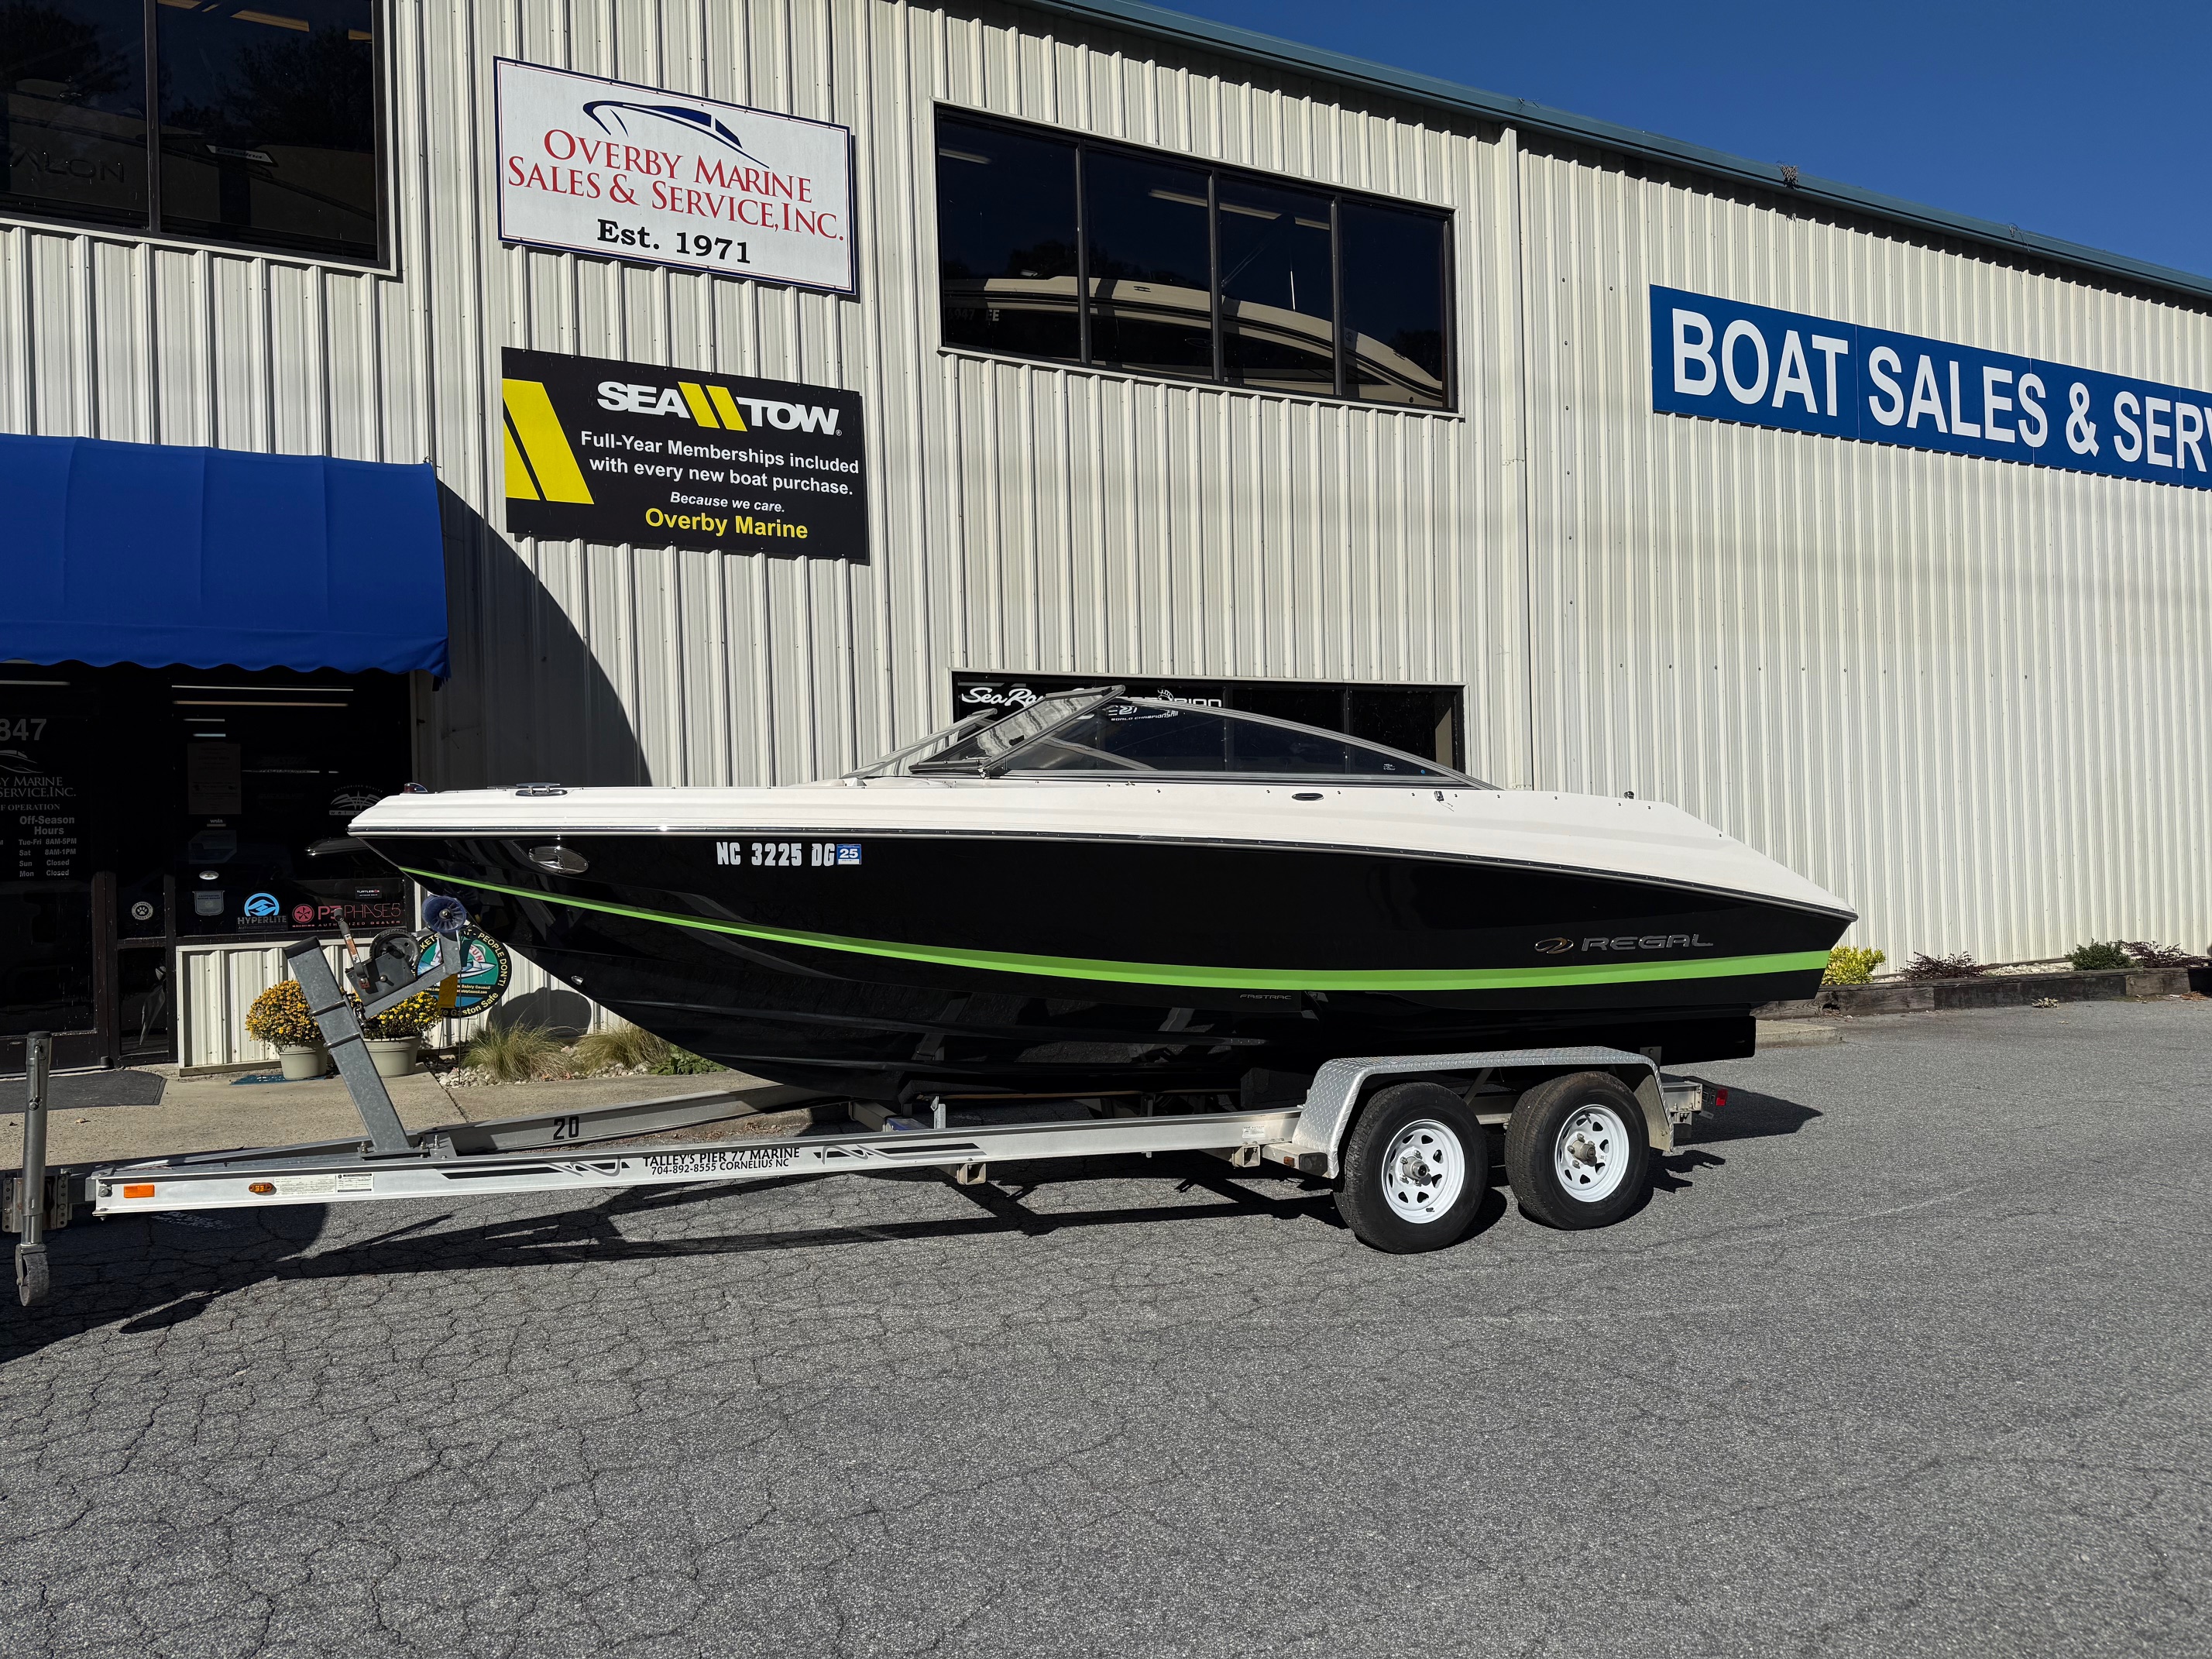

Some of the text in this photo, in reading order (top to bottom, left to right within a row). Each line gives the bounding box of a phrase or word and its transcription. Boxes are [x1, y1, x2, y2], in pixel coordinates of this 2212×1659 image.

[544, 129, 812, 203] OVERBY MARINE
[508, 156, 601, 199] SALES
[610, 173, 640, 206] &
[597, 218, 750, 264] Est. 1971
[596, 381, 690, 419] SEA
[1672, 307, 2212, 472] BOAT SALES & SER
[581, 431, 859, 475] Full-Year Memberships included
[589, 457, 854, 496] with every new boat purchase.
[670, 491, 785, 513] Because we care.
[645, 508, 809, 540] Overby Marine
[961, 686, 1008, 705] Sea
[0, 718, 47, 741] 847
[14, 776, 64, 787] MARINE
[8, 803, 60, 812] OPERATION
[19, 816, 75, 825] Off-Season
[34, 826, 64, 836] Hours
[716, 841, 836, 867] NC 3225 DG
[840, 848, 859, 859] 25
[237, 915, 287, 925] HYPERLITE
[478, 933, 505, 957] PEOPLE
[1582, 933, 1713, 951] REGAL
[497, 958, 508, 987] DON'T!
[450, 1005, 482, 1016] Gaston
[481, 992, 499, 1008] Safe
[553, 1116, 579, 1140] 20
[643, 1147, 800, 1167] TALLEY'S PIER 77 MARINE
[651, 1159, 789, 1175] 704-892-8555 CORNELIUS NC
